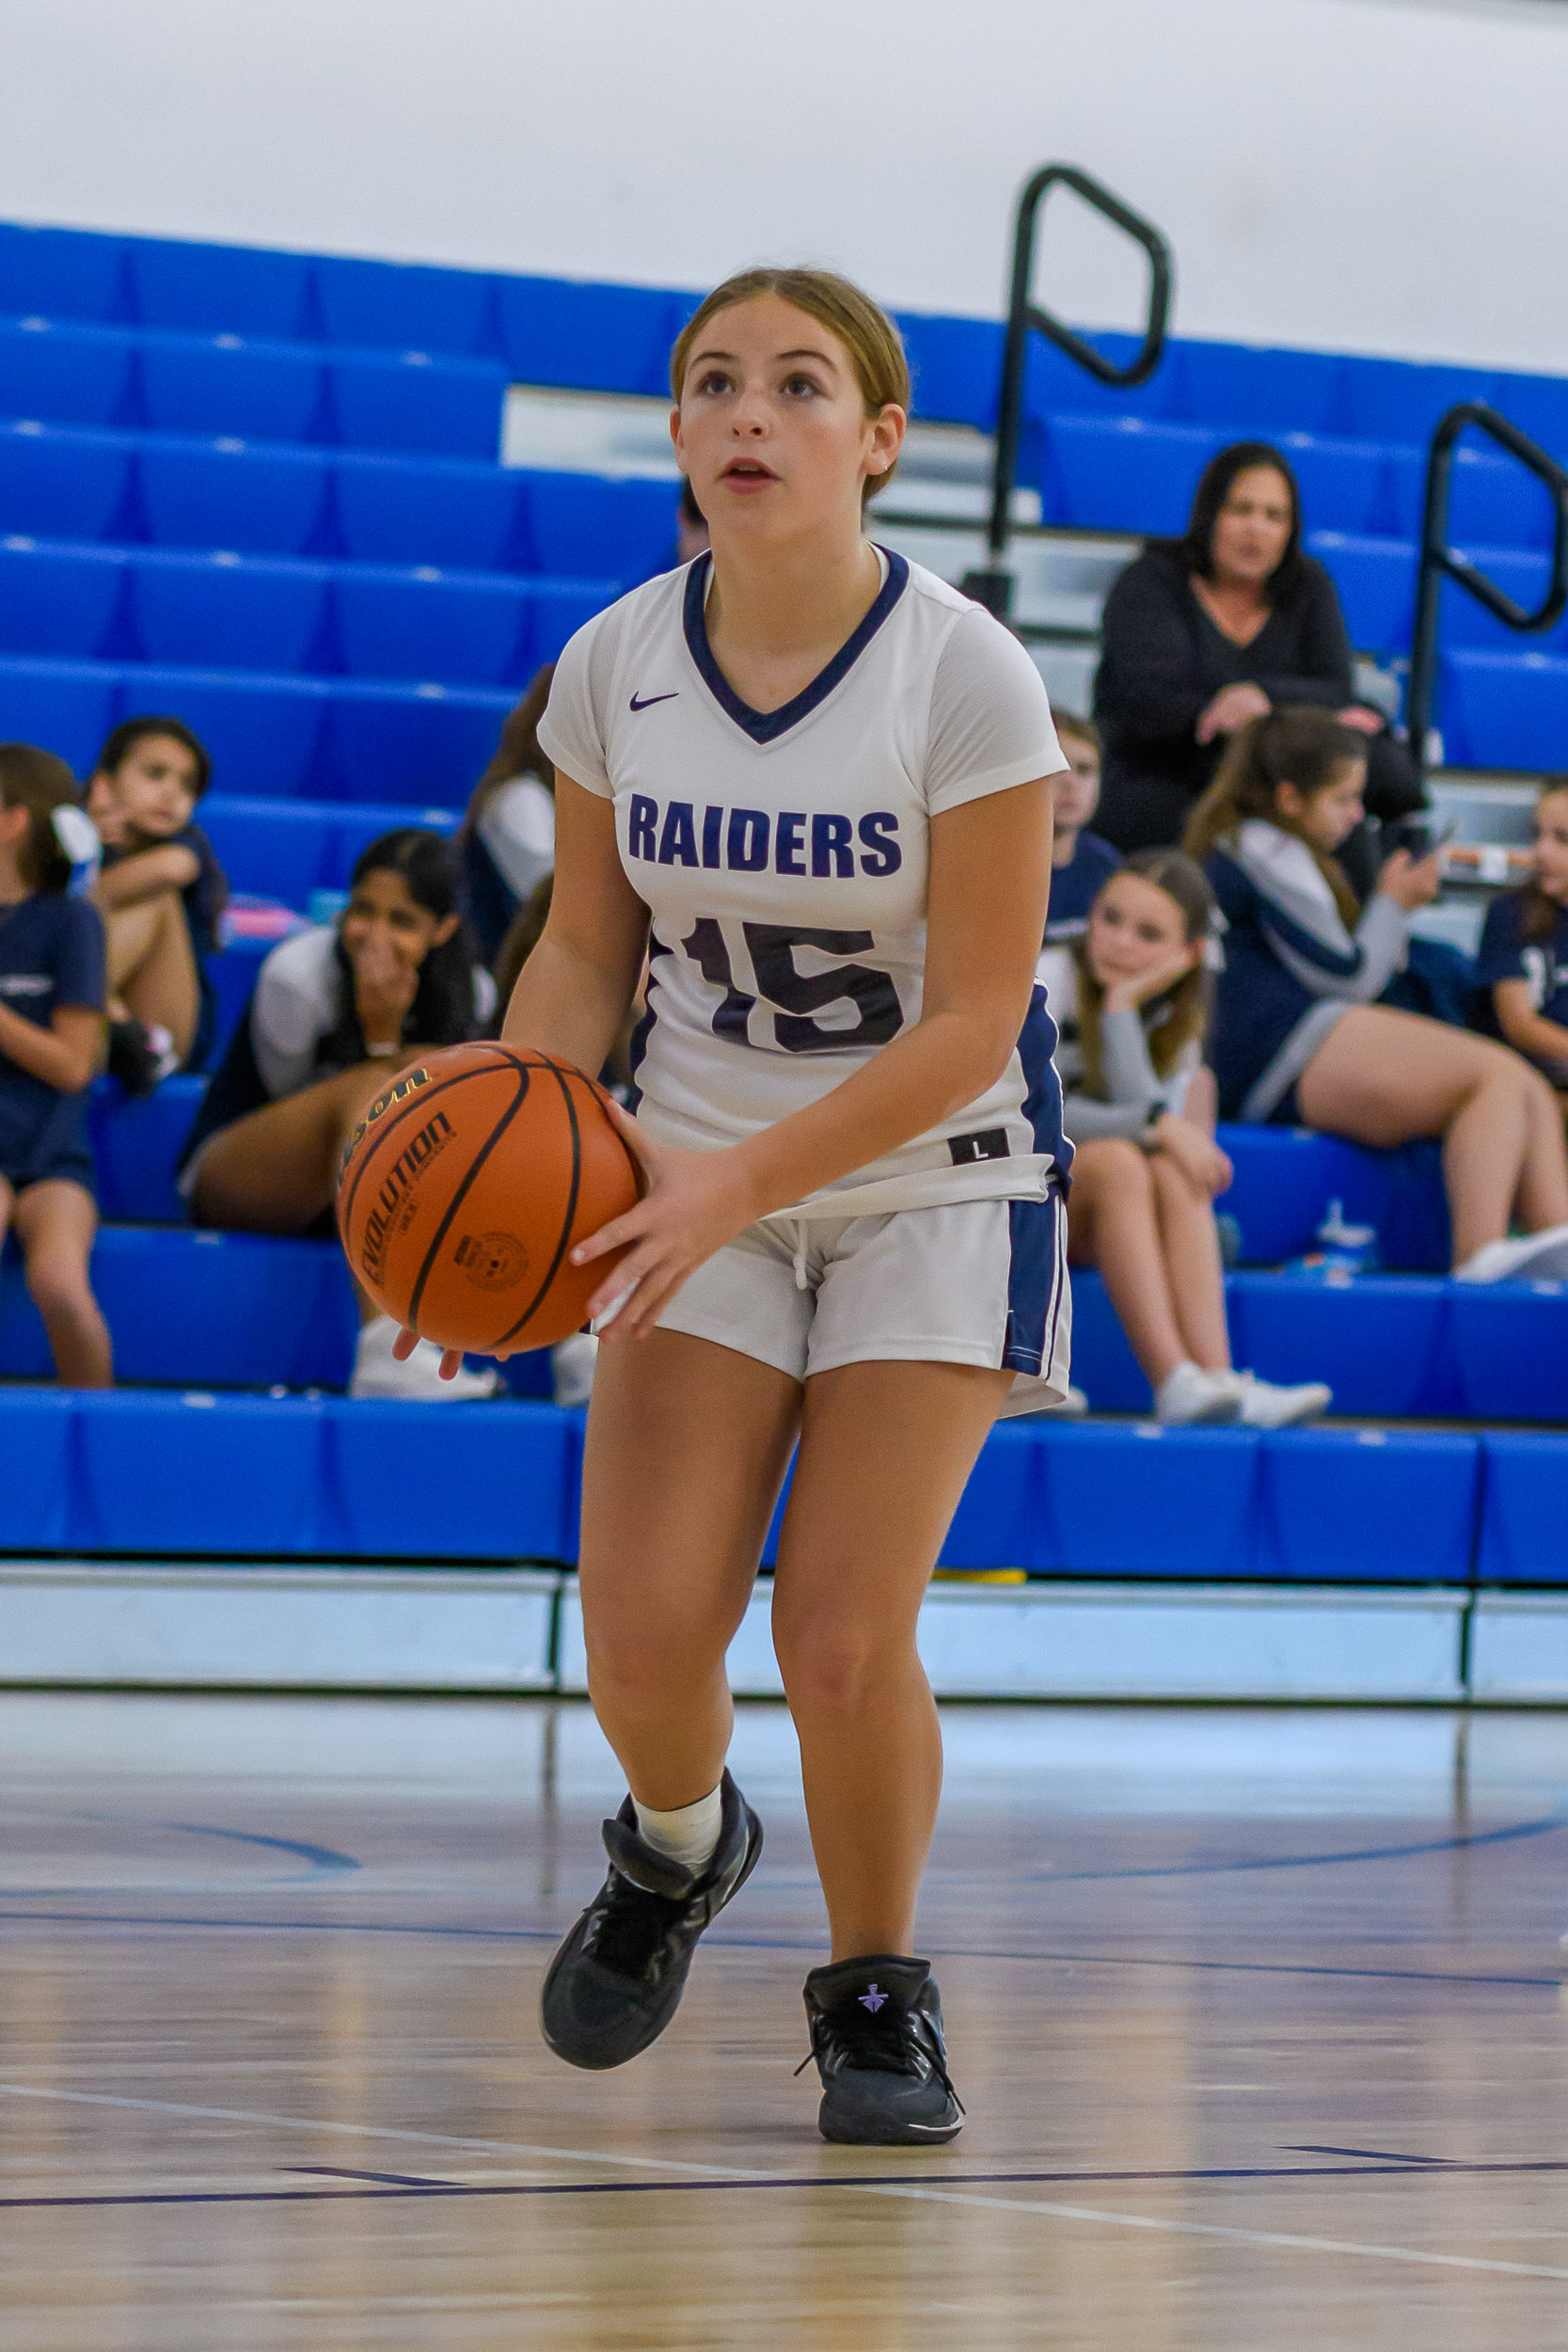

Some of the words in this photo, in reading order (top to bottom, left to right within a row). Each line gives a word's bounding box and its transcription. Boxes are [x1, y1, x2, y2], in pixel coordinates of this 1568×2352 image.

[628, 793, 903, 880] RAIDERS
[679, 916, 905, 1054] 15
[360, 1111, 451, 1290] EVOLUTION
[973, 1141, 989, 1159] L
